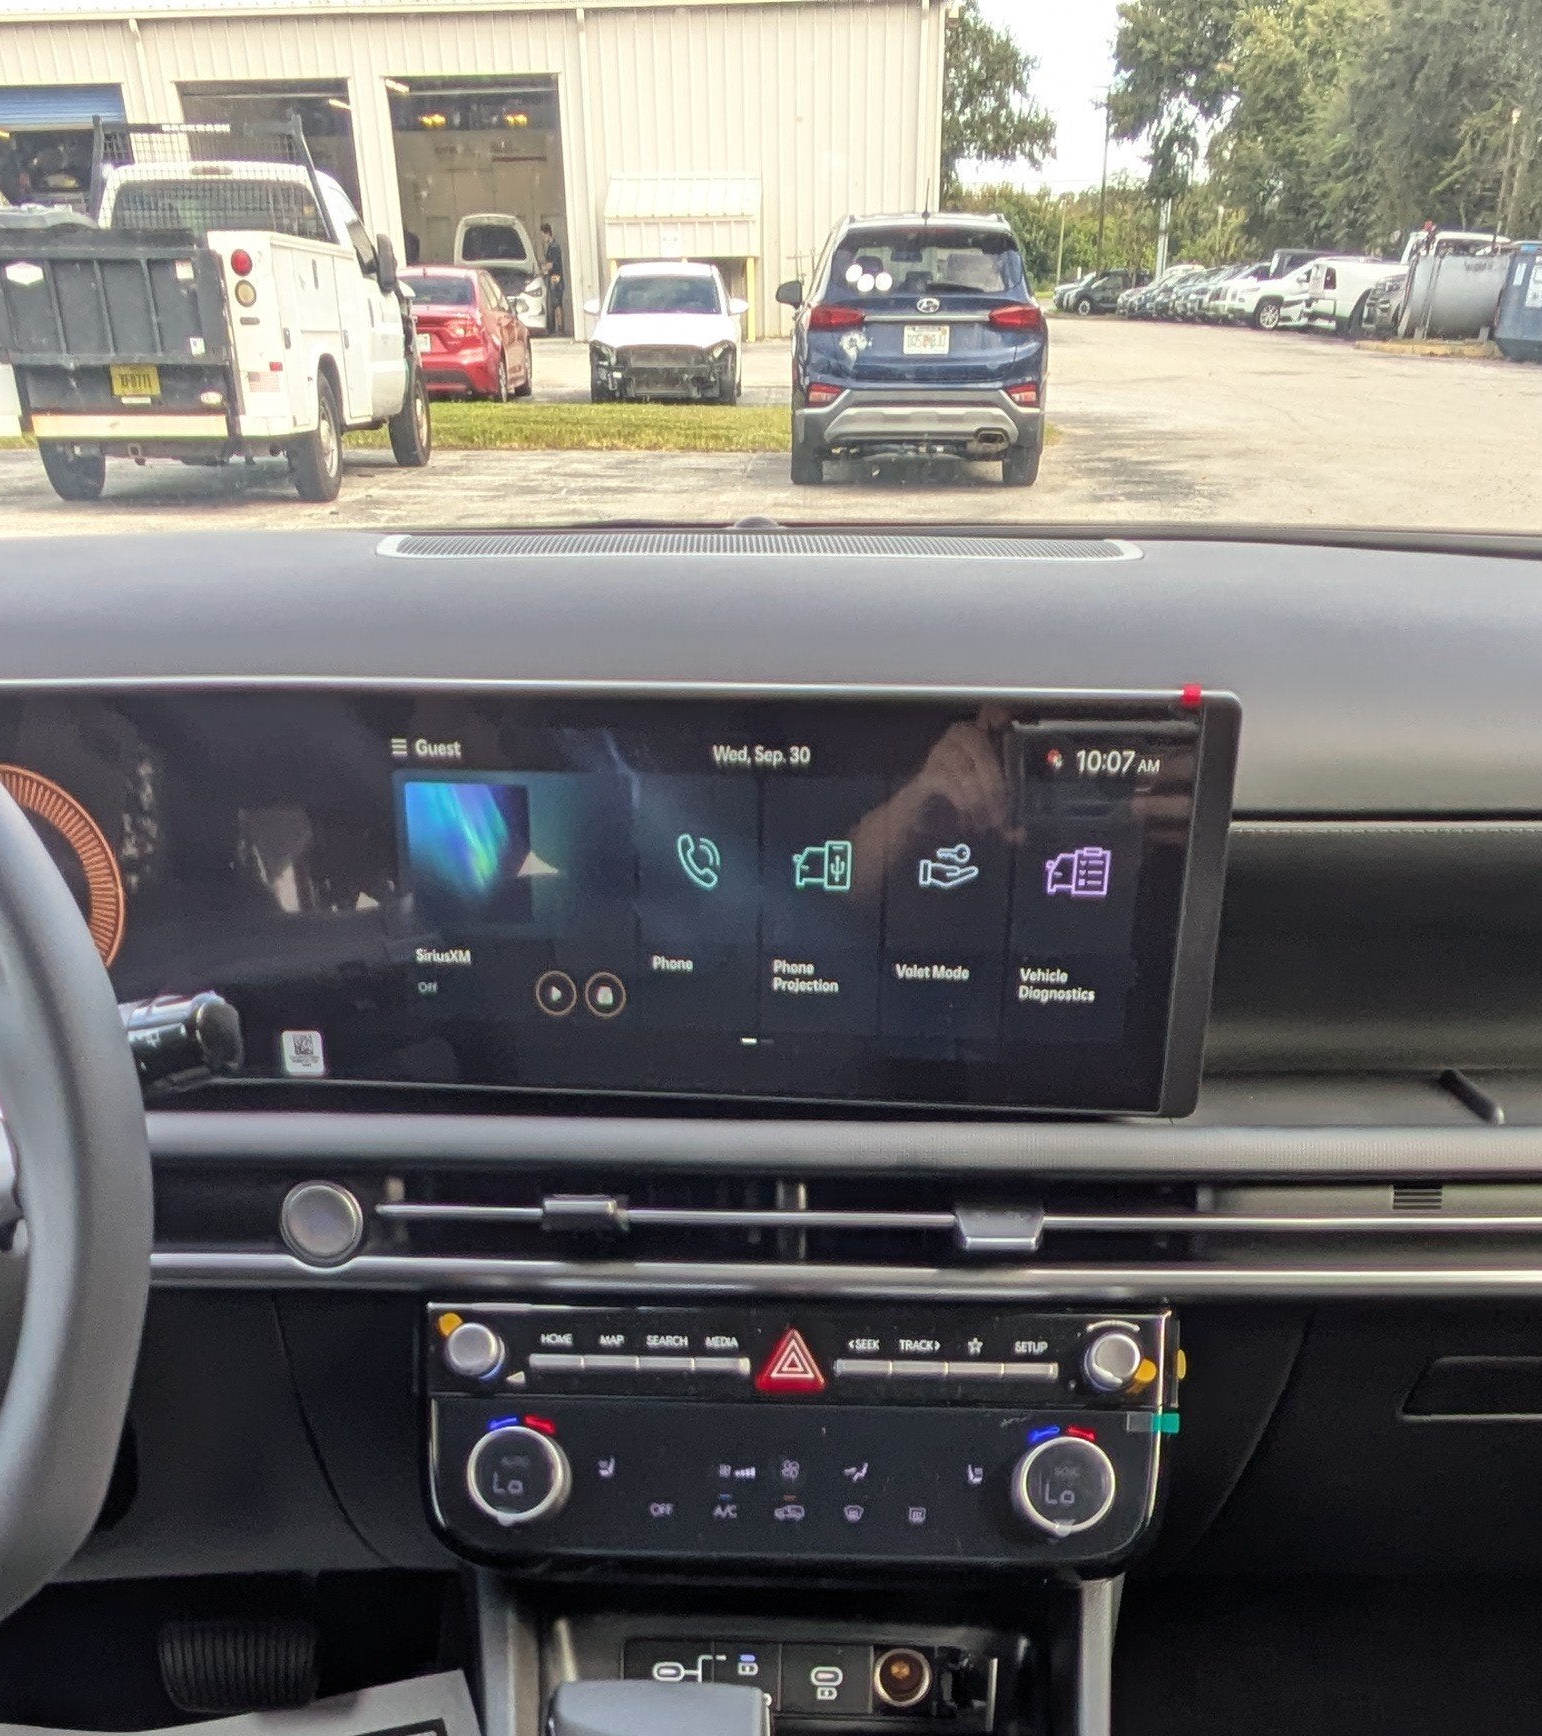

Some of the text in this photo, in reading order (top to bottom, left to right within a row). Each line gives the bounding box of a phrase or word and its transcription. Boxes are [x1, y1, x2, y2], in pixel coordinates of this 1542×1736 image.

[414, 738, 463, 757] Guest
[712, 743, 811, 766] Wed, Sep. 30
[1076, 749, 1160, 773] 10:07 AM
[415, 947, 472, 966] SiriusXM
[651, 954, 694, 972] Phone
[772, 958, 815, 976] Phone
[895, 963, 970, 982] Valet Mode
[1019, 967, 1069, 984] Vehicle
[417, 981, 438, 995] Off
[771, 976, 839, 994] Projection
[1018, 984, 1096, 1004] Diagnostics
[540, 1333, 574, 1347] HOME
[598, 1334, 625, 1347] MAP
[645, 1334, 689, 1348] SEARCH
[704, 1335, 740, 1349] MEDIA
[898, 1338, 934, 1352] TRACK
[1014, 1340, 1049, 1354] SETUP
